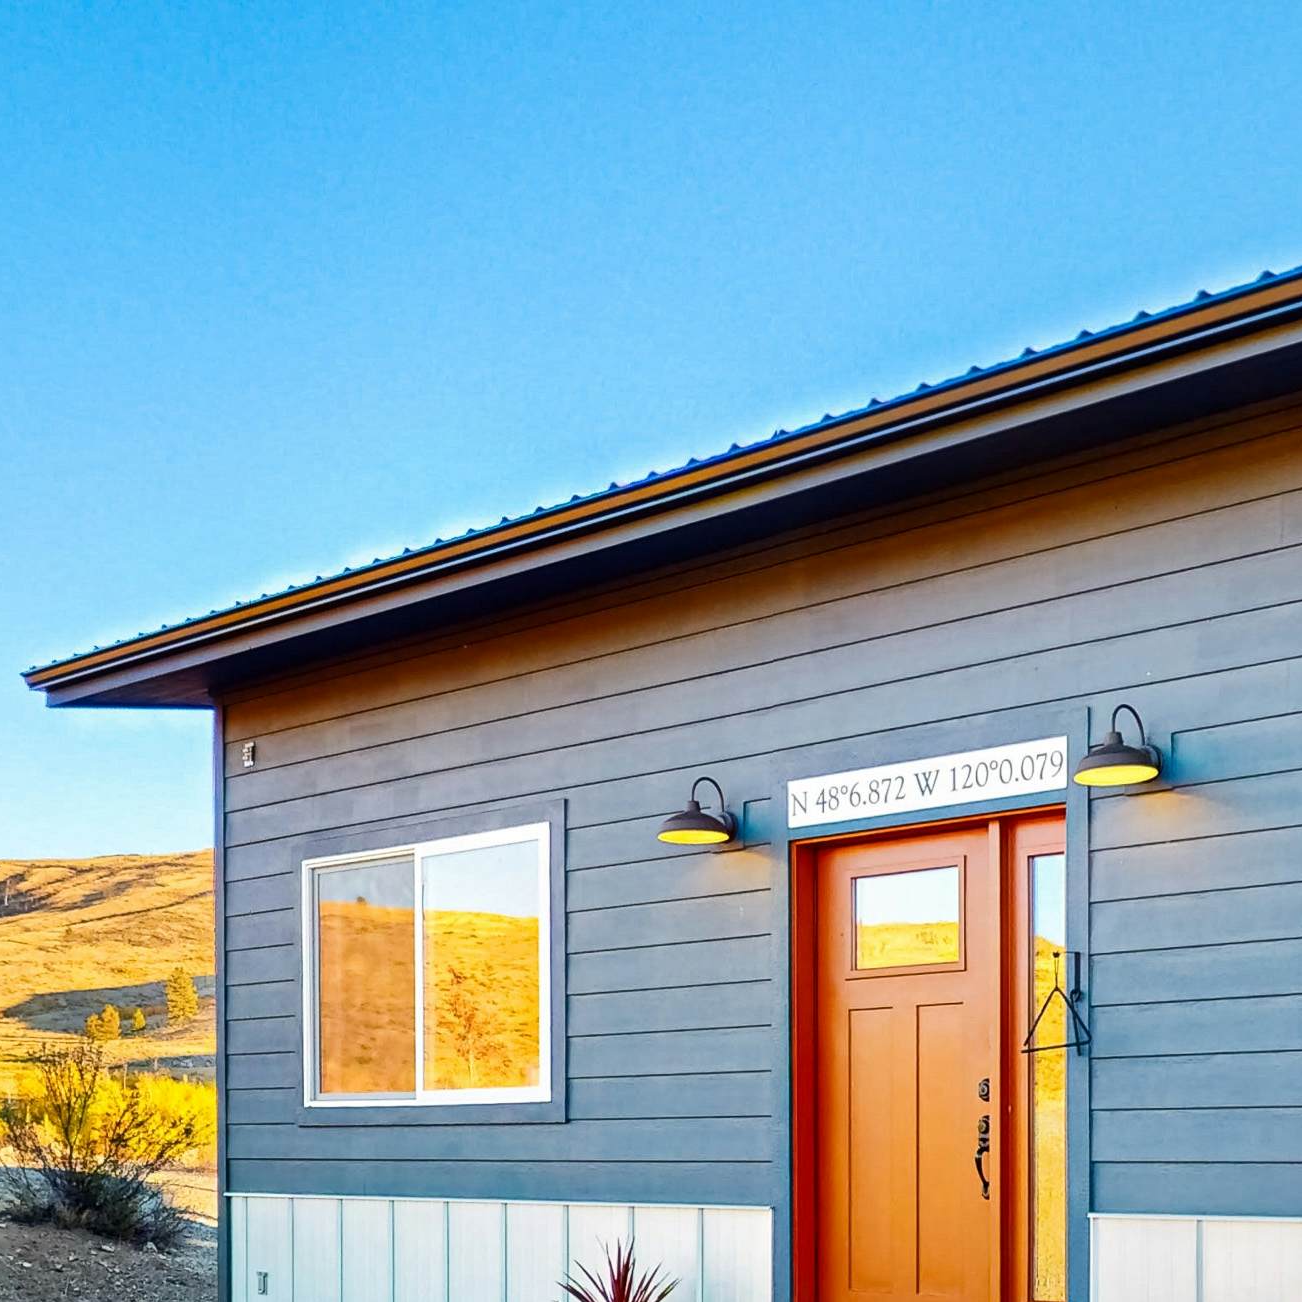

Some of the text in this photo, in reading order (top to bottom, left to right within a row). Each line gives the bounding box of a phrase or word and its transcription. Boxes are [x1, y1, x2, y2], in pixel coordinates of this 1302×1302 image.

[791, 750, 1064, 817] N 48°6.872 W 120°0.079
